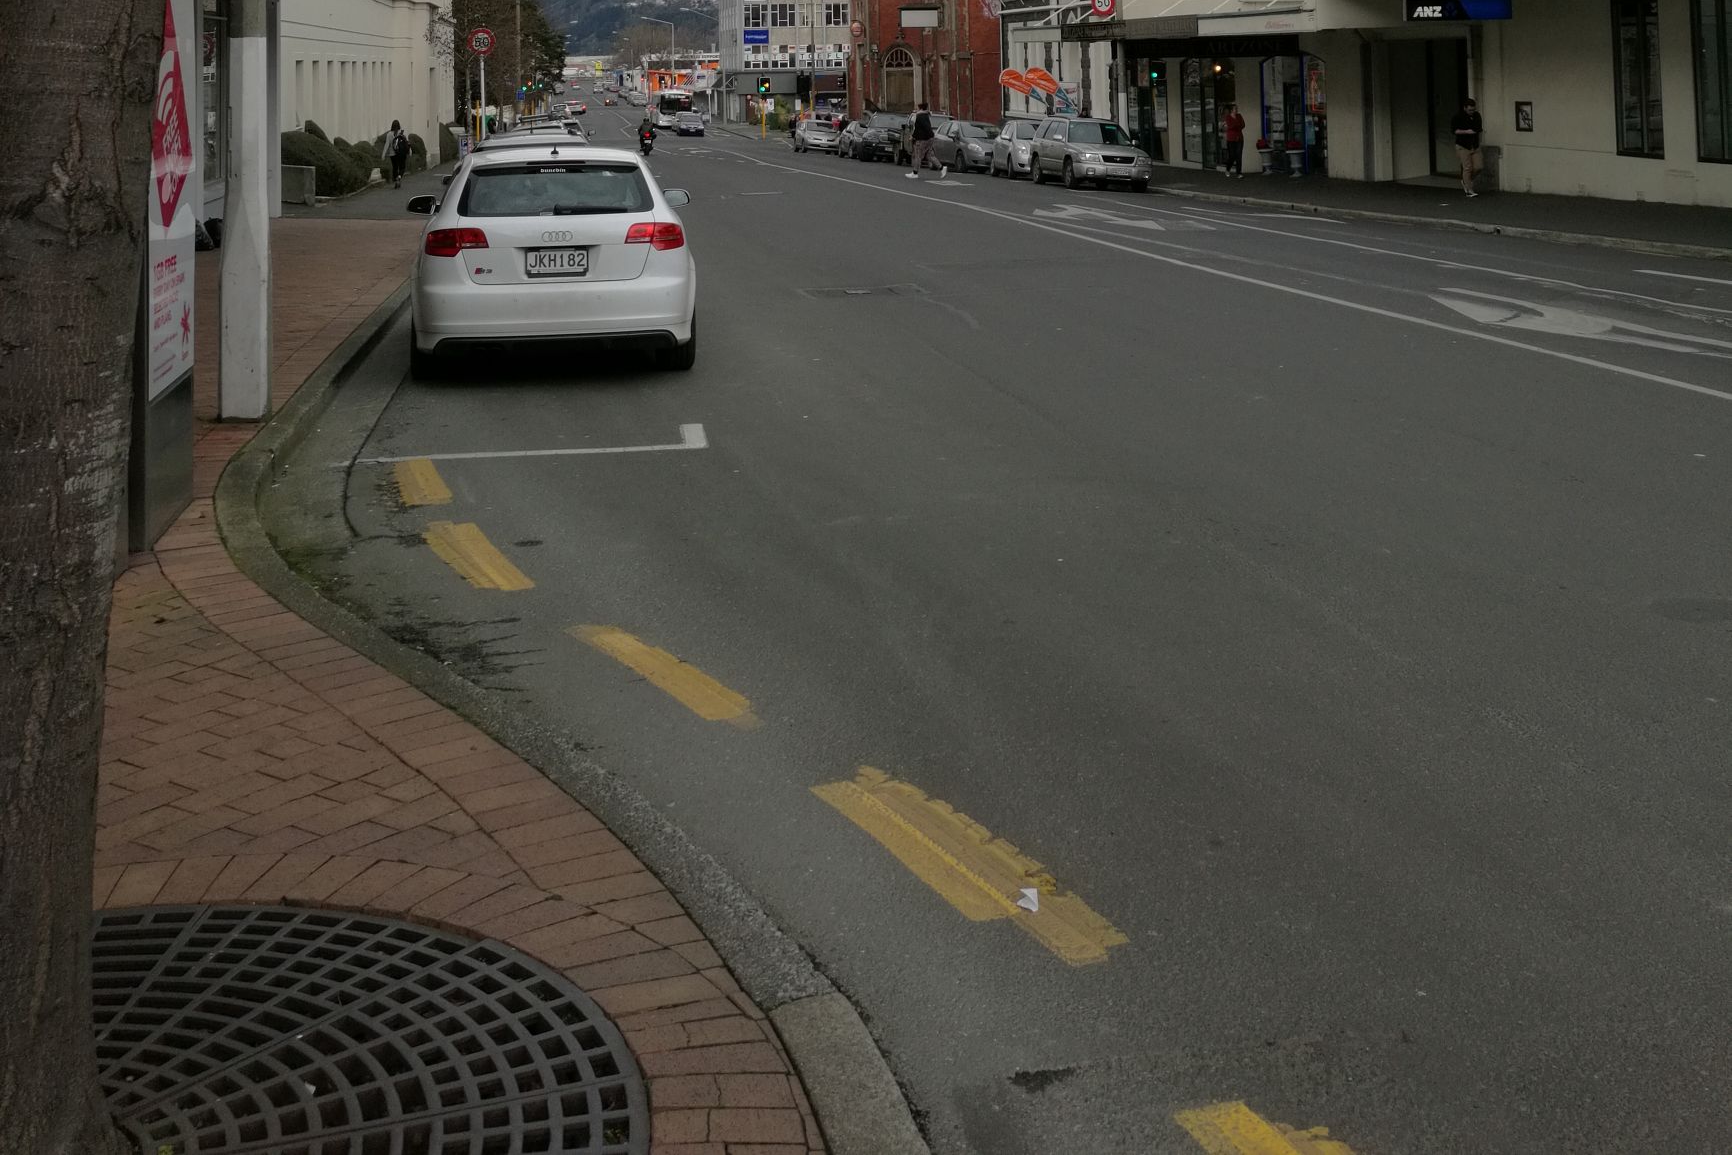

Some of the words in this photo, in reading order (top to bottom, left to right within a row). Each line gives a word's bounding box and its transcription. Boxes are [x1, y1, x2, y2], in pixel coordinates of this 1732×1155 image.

[1412, 5, 1443, 18] ANZ
[474, 36, 490, 47] 50
[528, 252, 586, 269] JKH182
